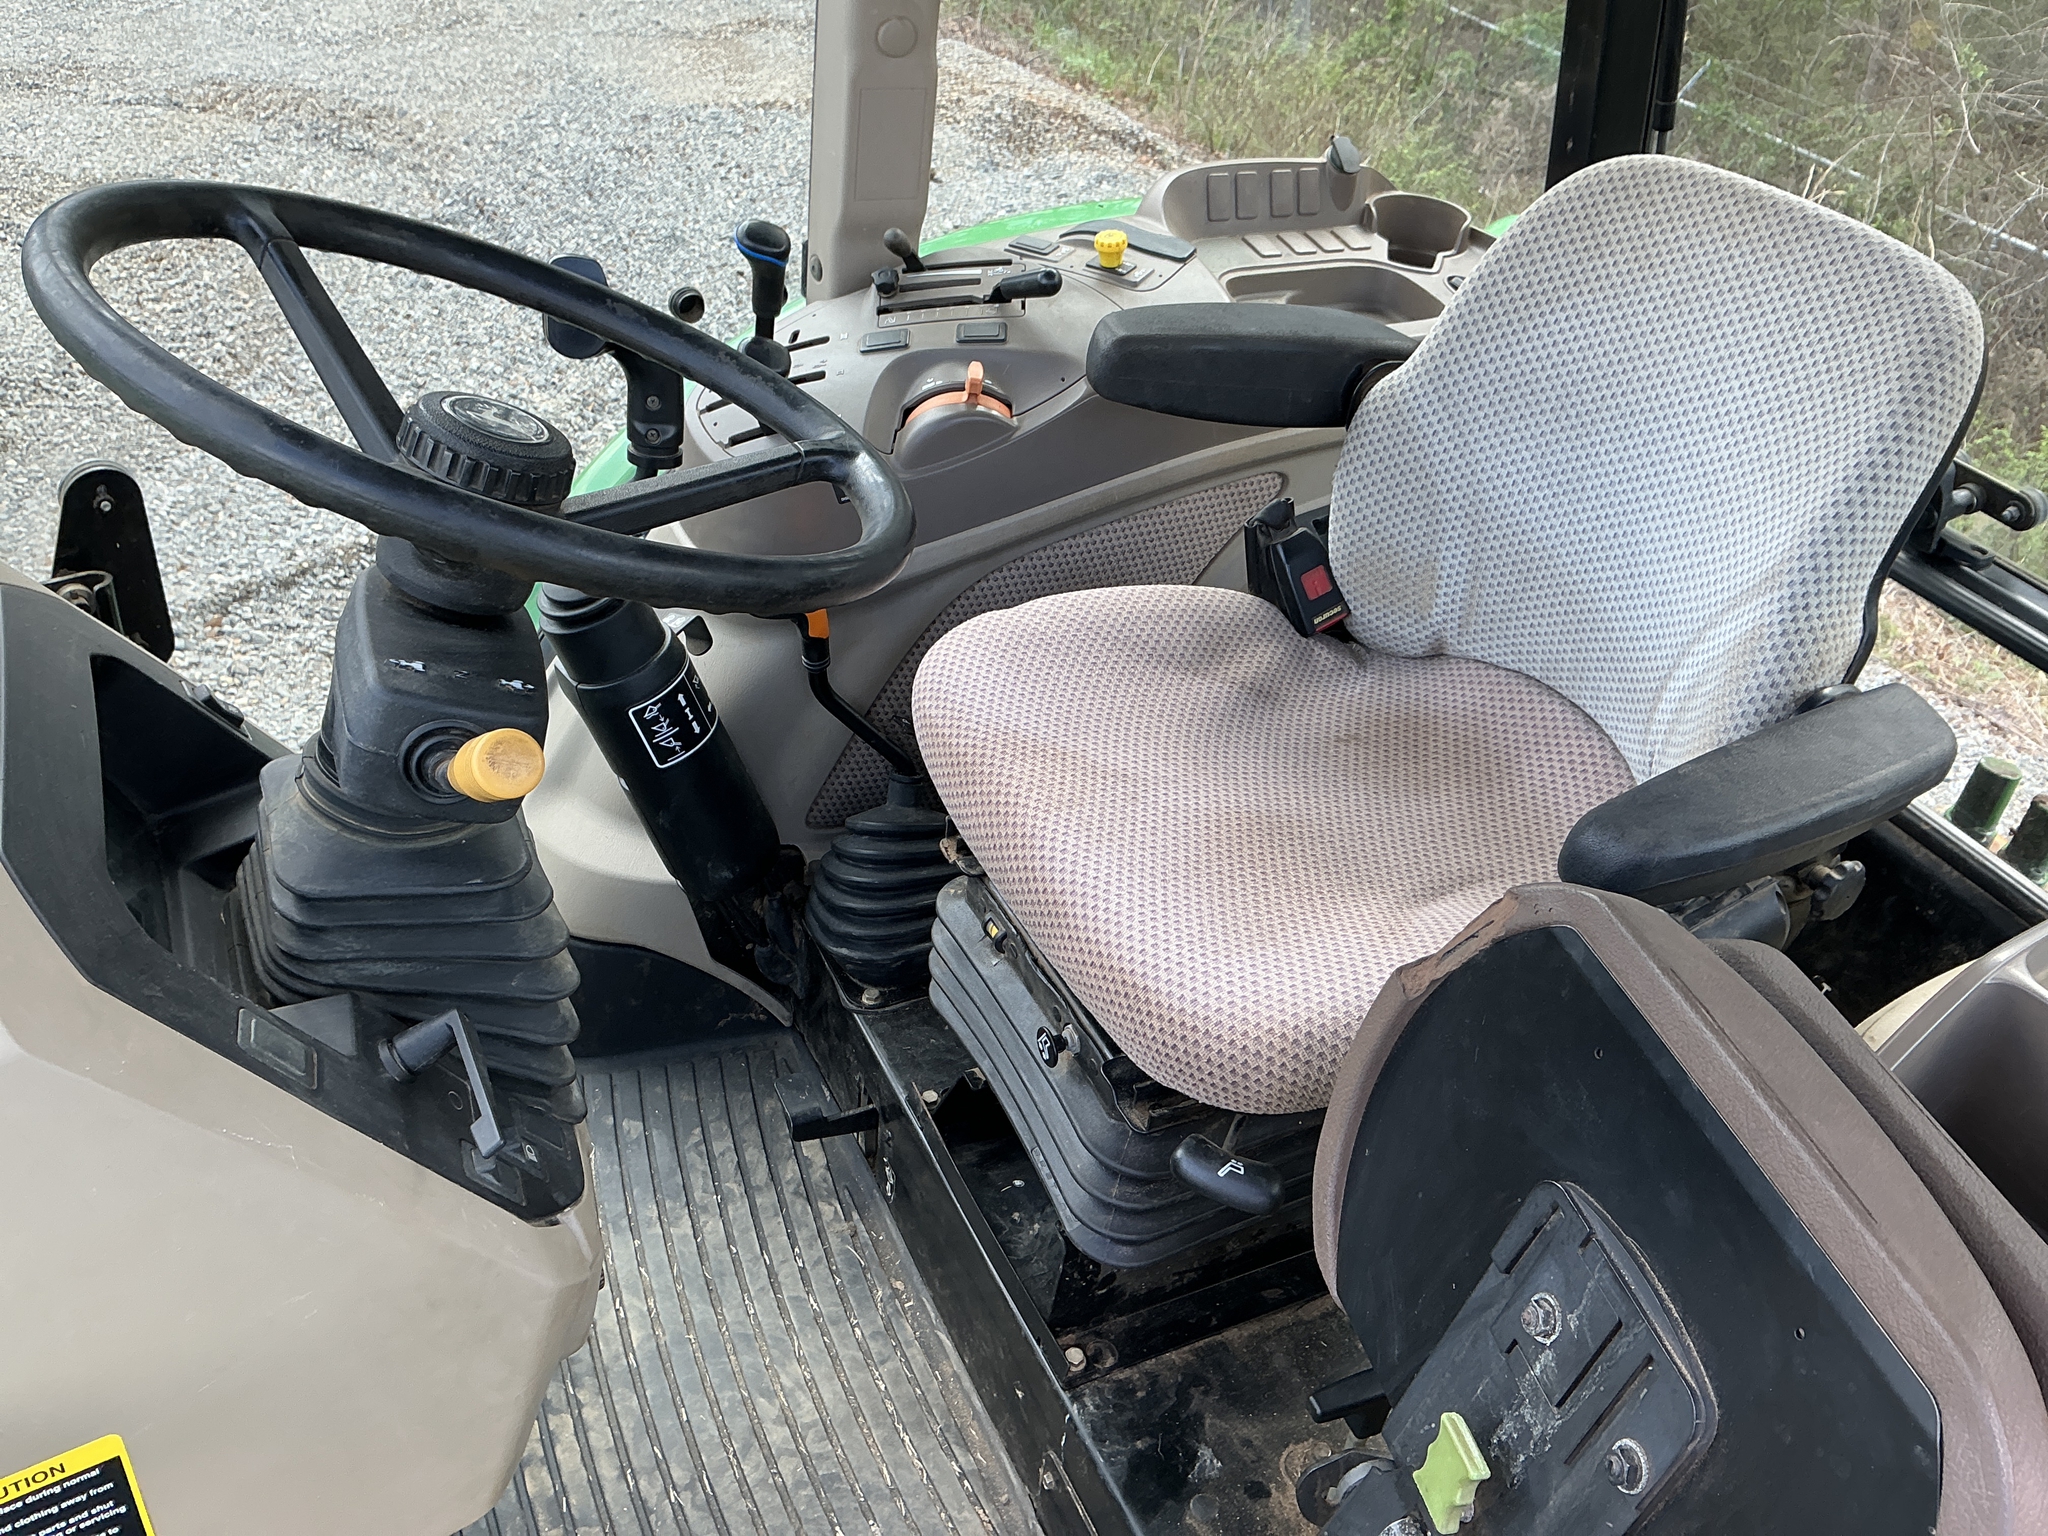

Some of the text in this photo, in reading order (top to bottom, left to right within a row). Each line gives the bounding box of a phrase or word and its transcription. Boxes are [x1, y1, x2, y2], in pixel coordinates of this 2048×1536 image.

[25, 1485, 62, 1504] during
[63, 1467, 100, 1489] normal
[14, 1505, 59, 1528] clothing
[60, 1493, 88, 1509] away
[89, 1482, 114, 1497] from
[38, 1500, 115, 1536] parts and shut
[65, 1505, 127, 1535] or servicing
[107, 1526, 120, 1535] to
